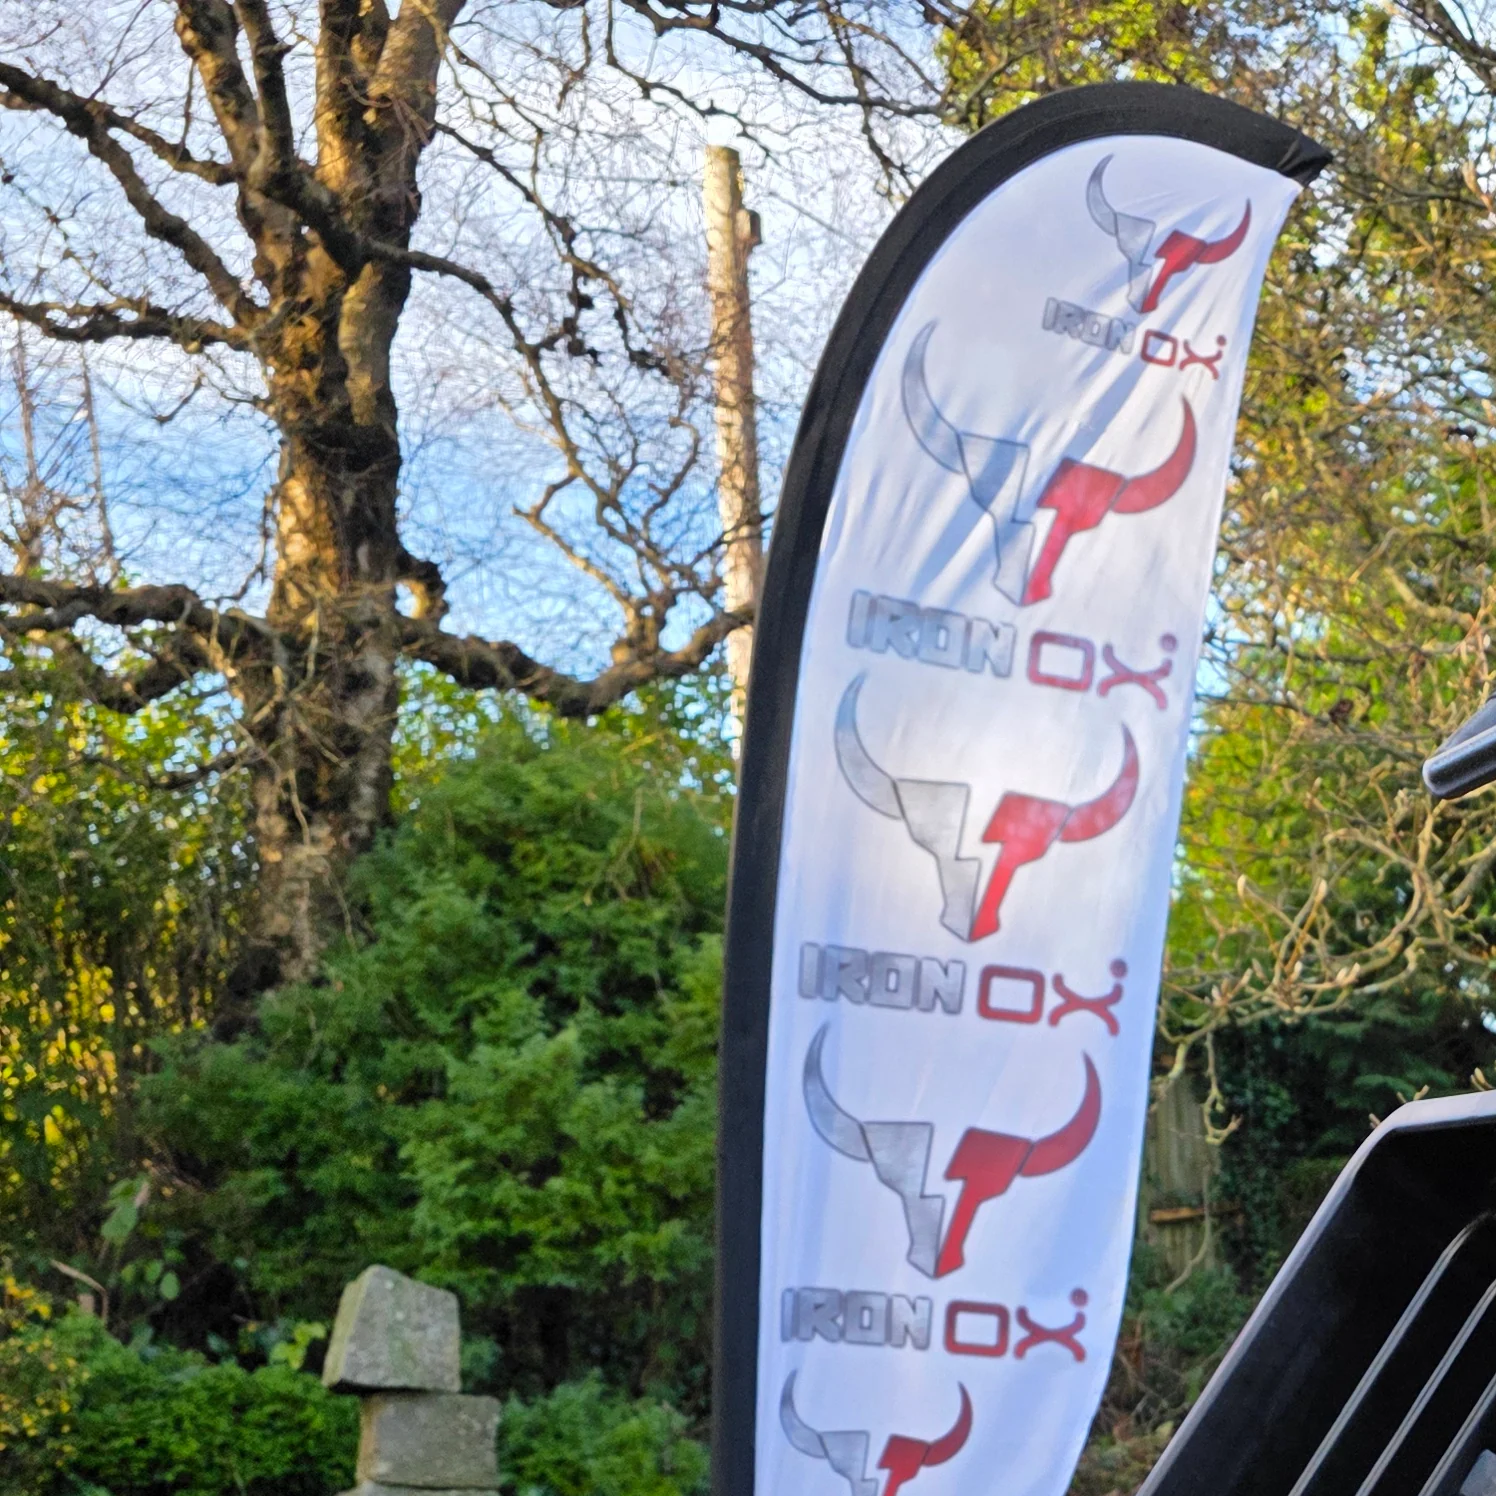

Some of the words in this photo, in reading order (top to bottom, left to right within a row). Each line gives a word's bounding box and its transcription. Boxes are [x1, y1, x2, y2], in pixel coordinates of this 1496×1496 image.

[1043, 297, 1136, 354] IRON
[846, 589, 1017, 678] IRON
[799, 942, 966, 1015] IRON
[781, 1287, 932, 1351] IRON
